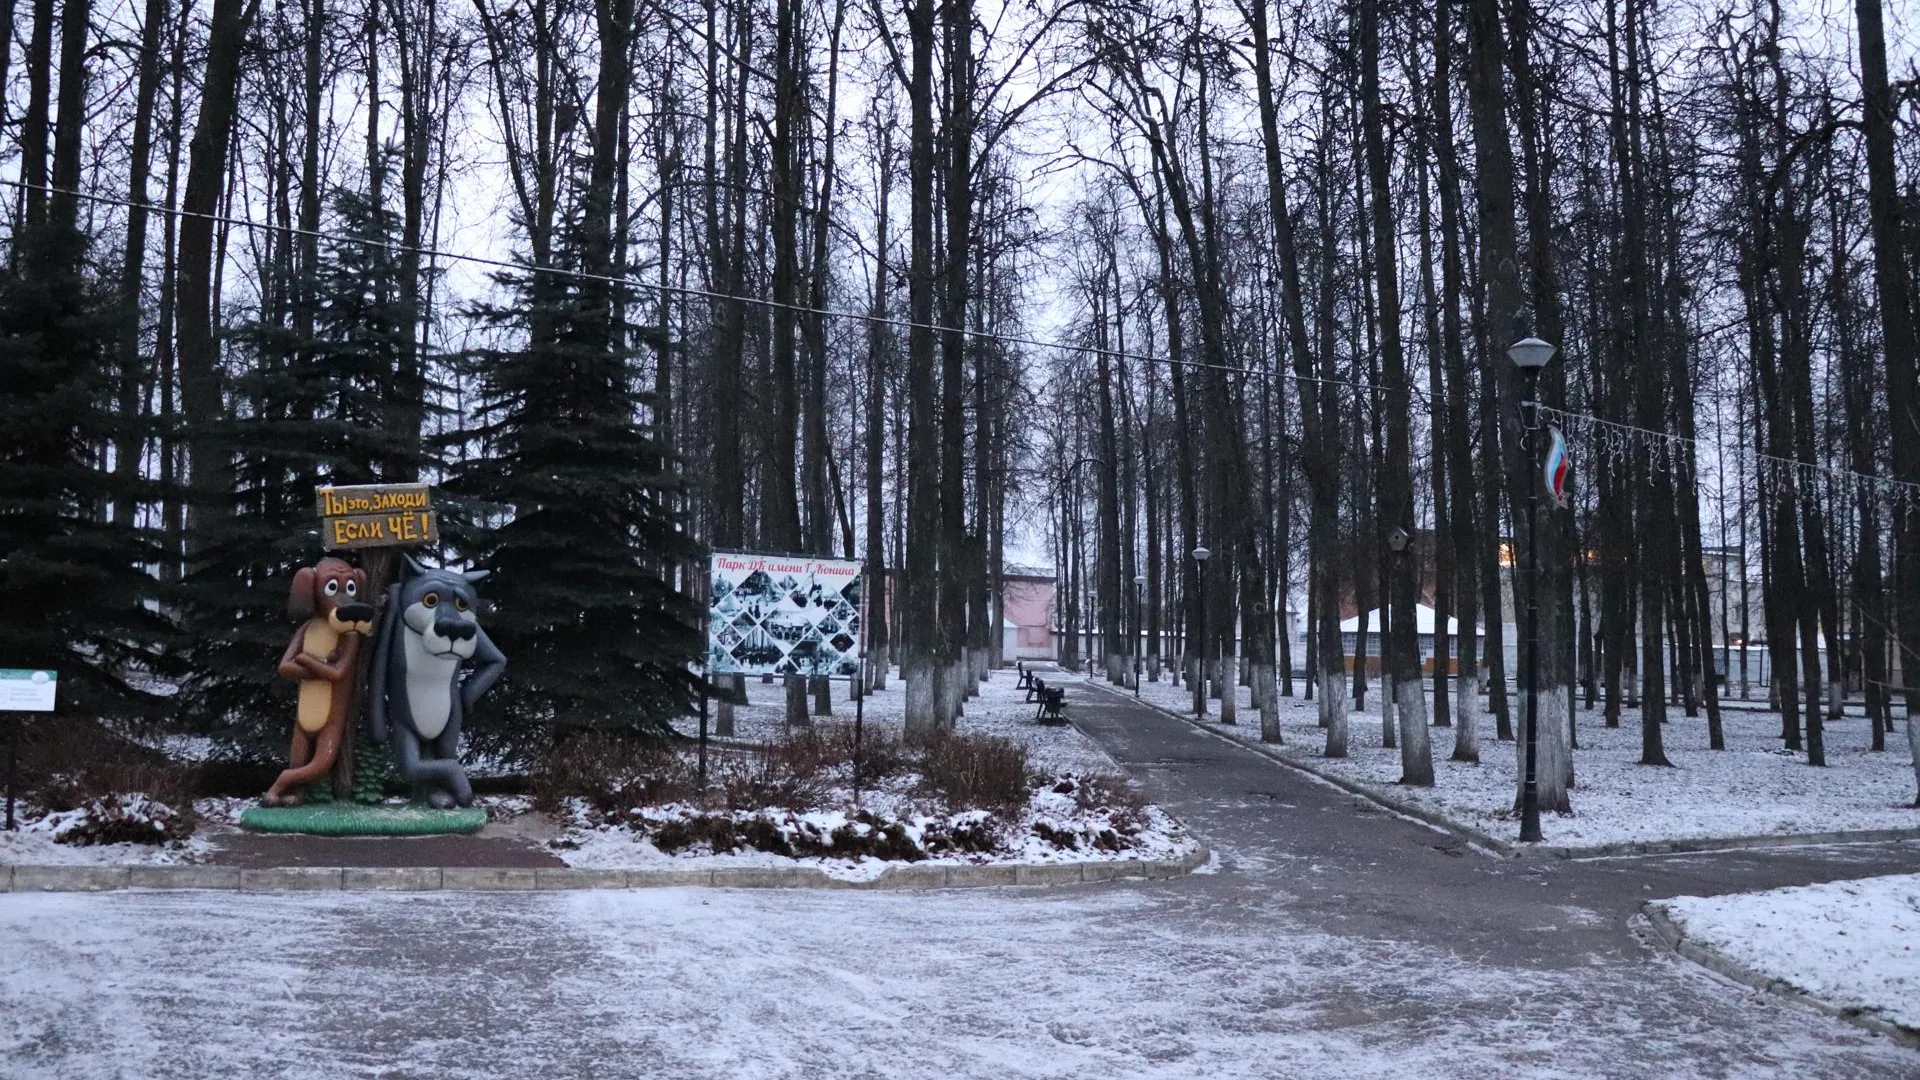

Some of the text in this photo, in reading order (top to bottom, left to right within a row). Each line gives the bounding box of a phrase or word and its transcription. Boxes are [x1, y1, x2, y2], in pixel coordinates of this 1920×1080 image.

[717, 558, 745, 571] Парк
[748, 561, 766, 571] ДК
[768, 564, 802, 573] имени
